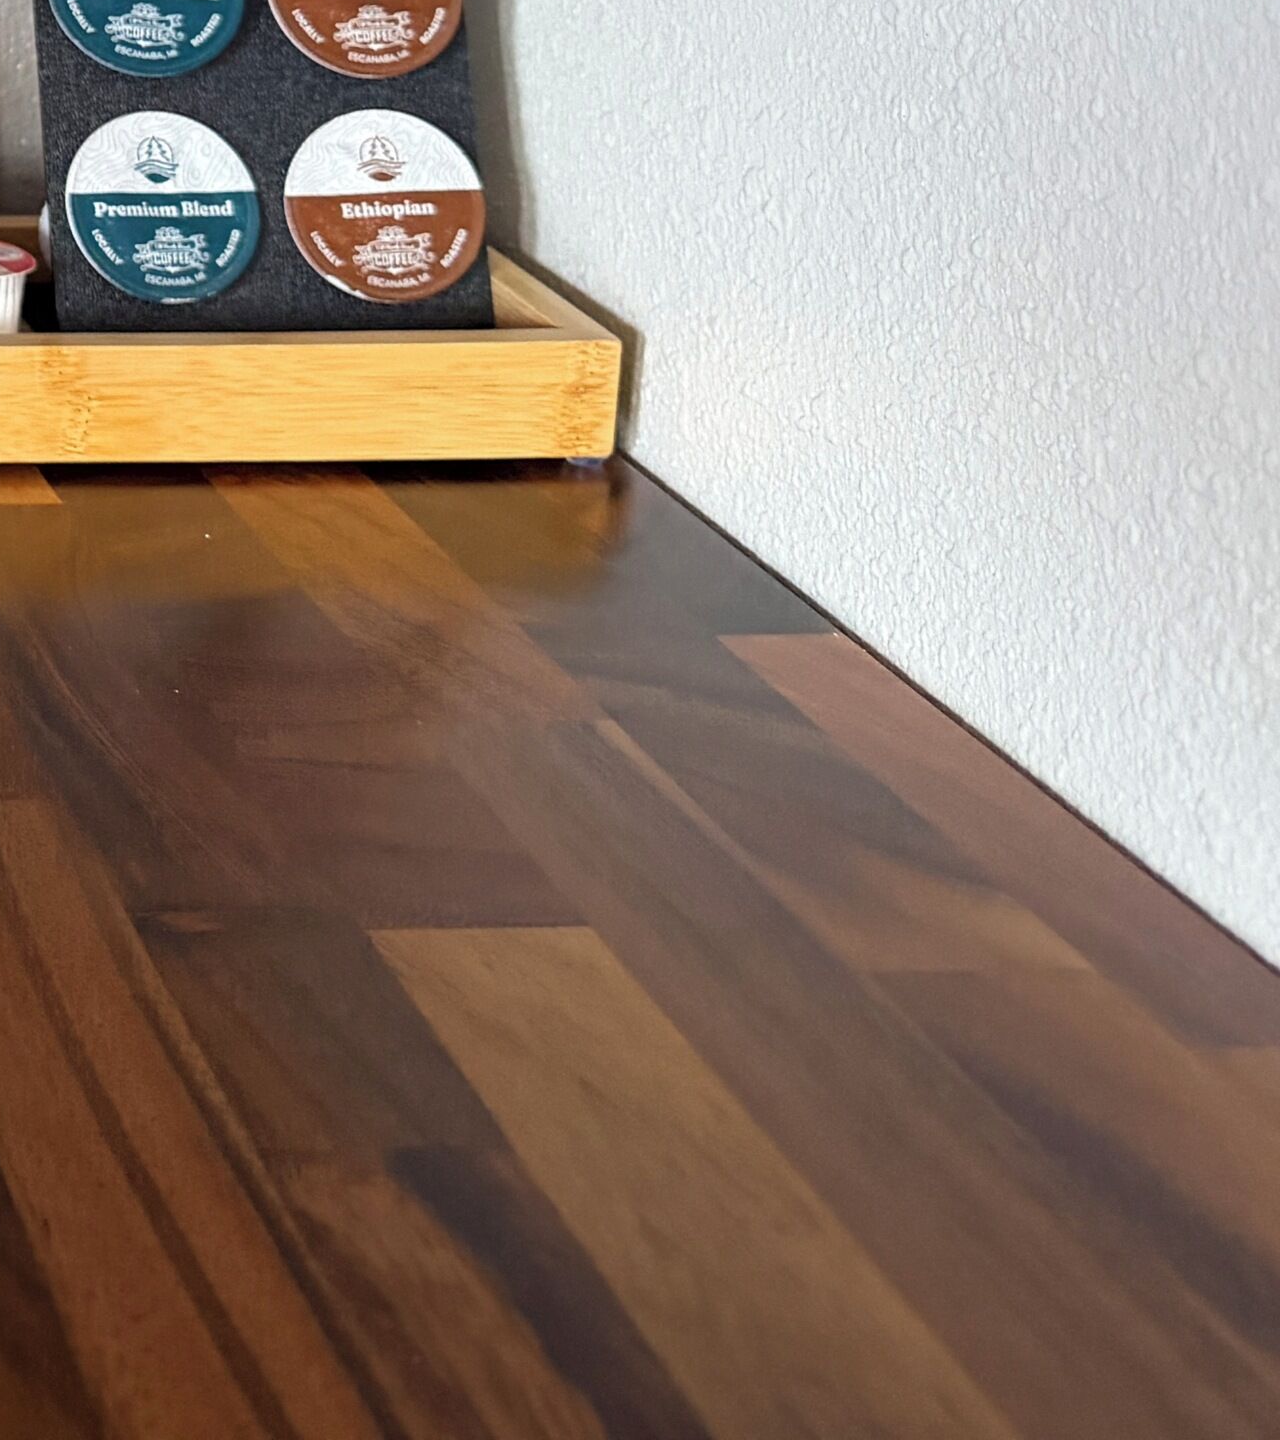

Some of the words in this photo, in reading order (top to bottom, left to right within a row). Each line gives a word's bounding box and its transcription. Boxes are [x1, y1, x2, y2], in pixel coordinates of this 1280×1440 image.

[93, 200, 179, 218] Premium
[181, 199, 235, 217] Blend
[341, 200, 437, 220] Ethiopian
[91, 228, 125, 265] LOCALLY
